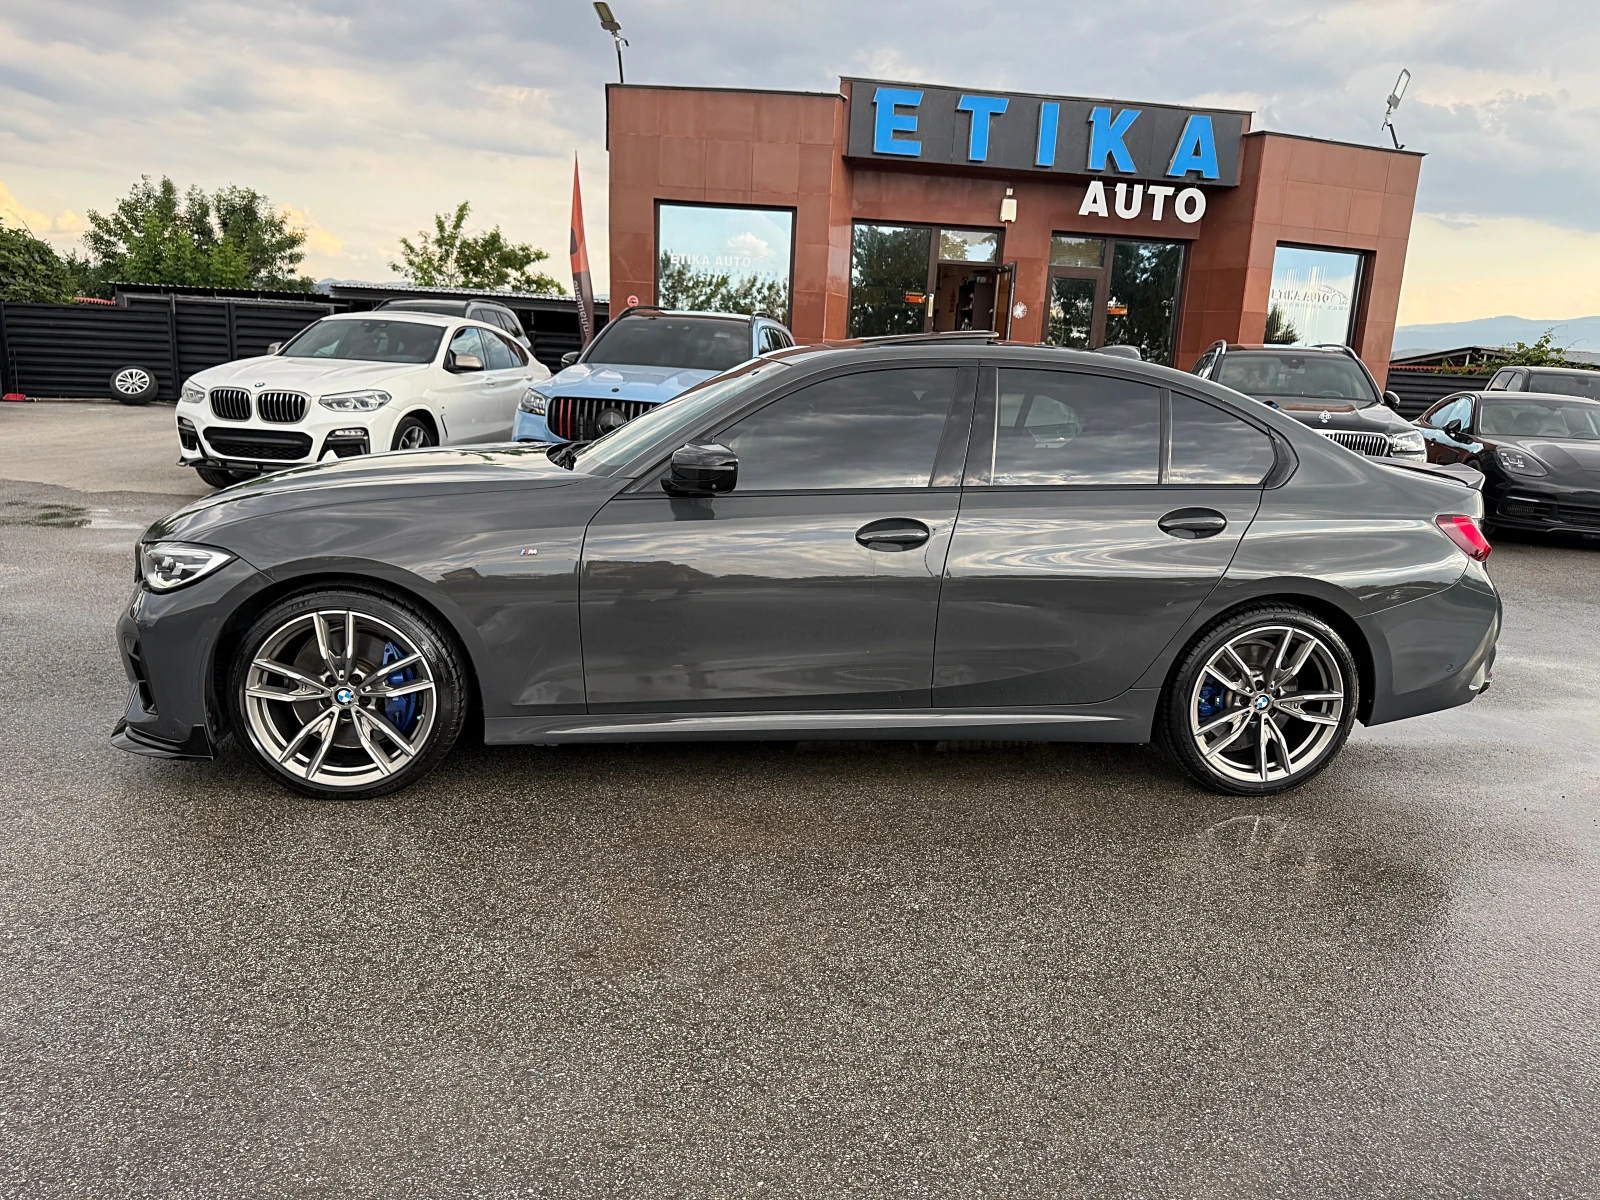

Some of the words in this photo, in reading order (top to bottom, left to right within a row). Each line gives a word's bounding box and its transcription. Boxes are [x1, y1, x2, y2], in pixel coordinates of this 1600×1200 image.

[873, 86, 1220, 180] ETIKA
[1078, 180, 1207, 224] AUTO
[670, 252, 710, 266] ETIKA
[715, 255, 752, 268] AUTO
